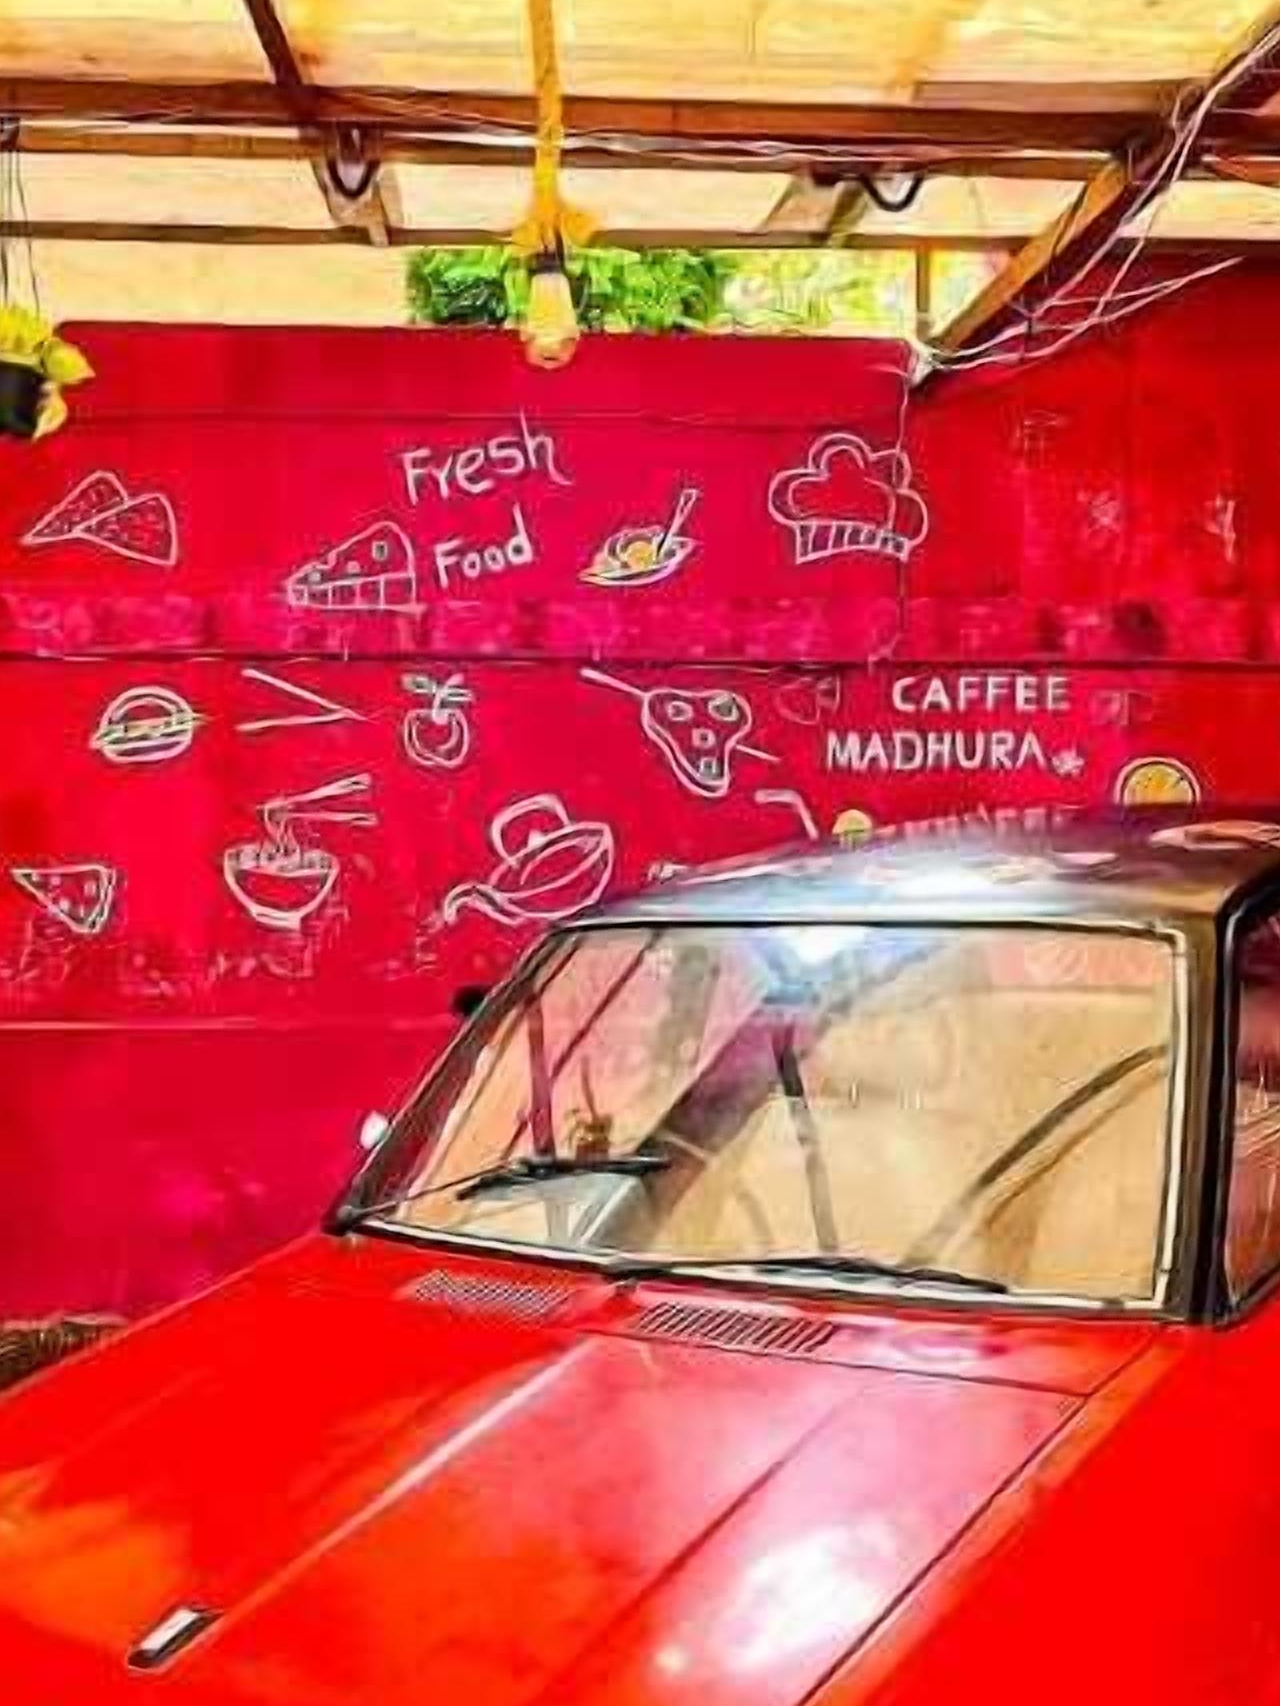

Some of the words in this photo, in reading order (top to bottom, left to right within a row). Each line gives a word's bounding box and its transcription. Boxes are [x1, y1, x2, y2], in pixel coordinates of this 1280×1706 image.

[400, 409, 573, 506] Fresh
[434, 501, 534, 589] Food
[891, 674, 1072, 713] CAFFEE
[826, 729, 1048, 780] MADHURA
